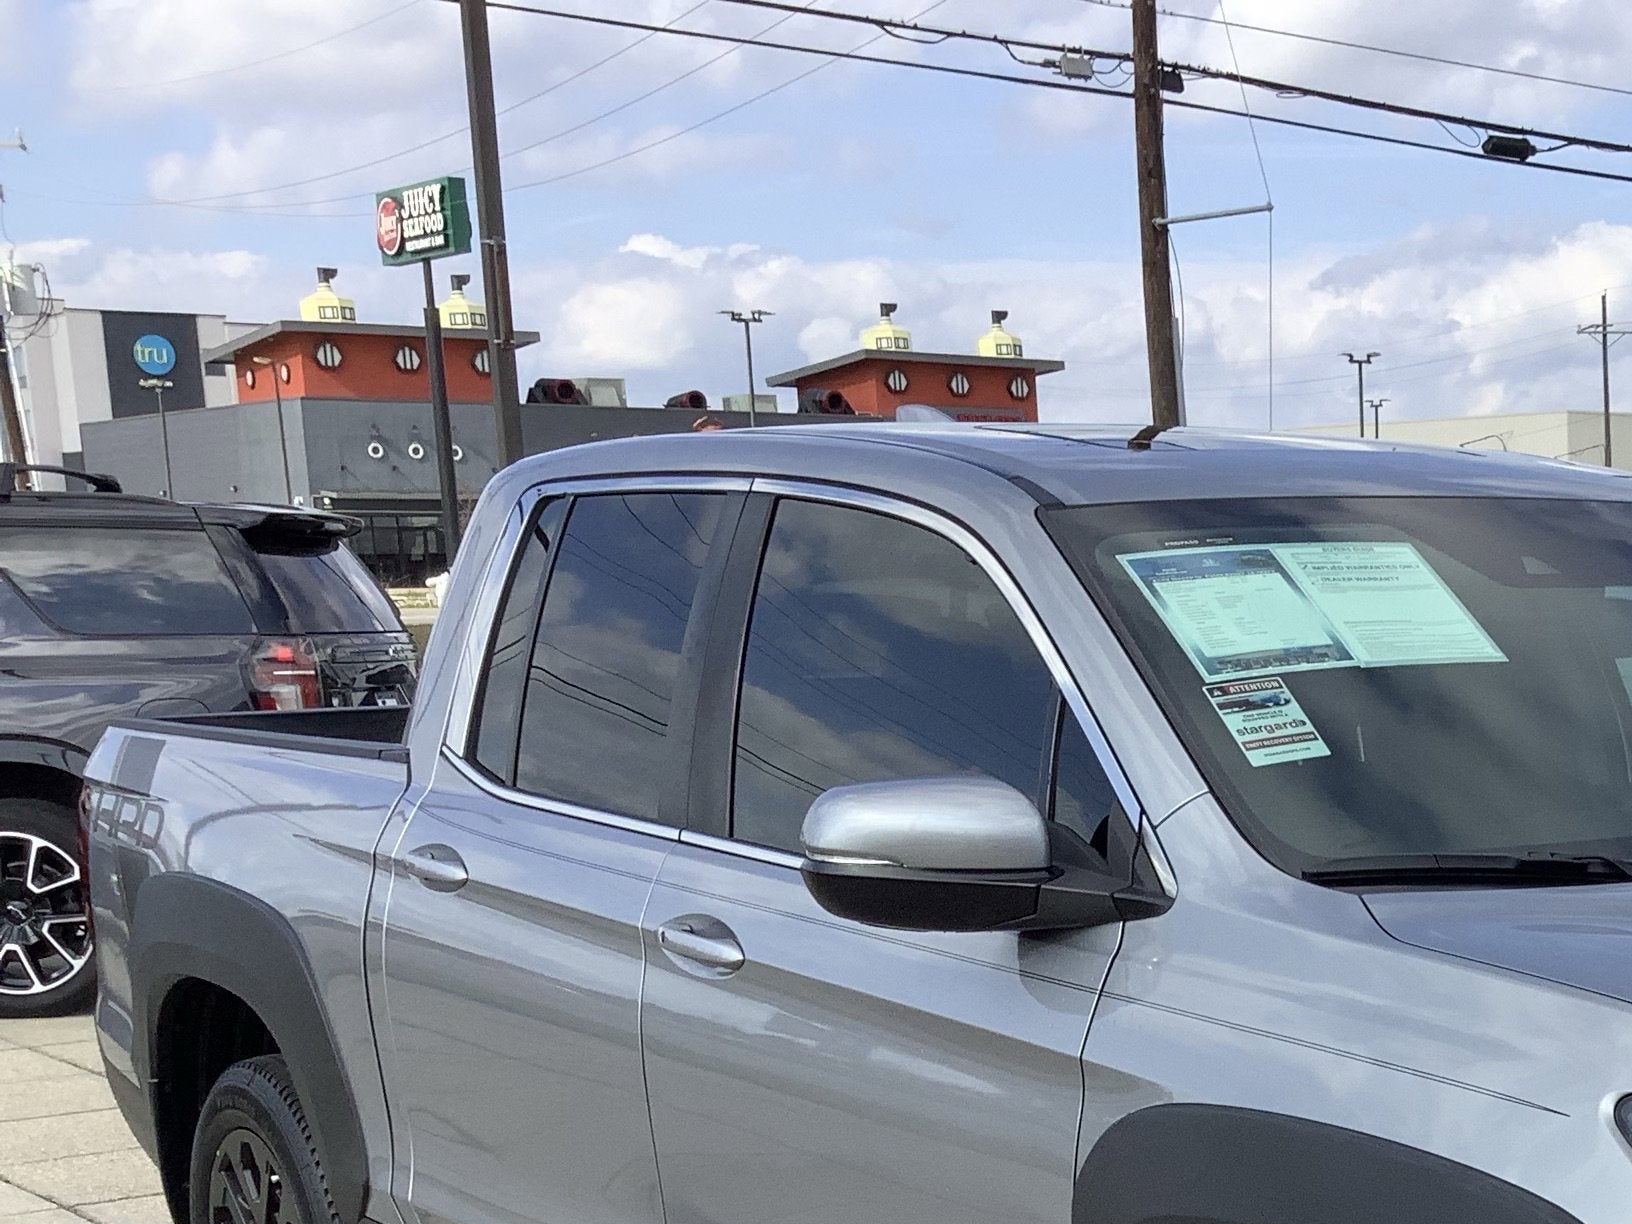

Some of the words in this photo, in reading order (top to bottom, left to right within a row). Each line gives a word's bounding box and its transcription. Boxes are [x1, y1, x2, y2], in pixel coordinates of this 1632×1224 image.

[401, 183, 441, 219] JUICY
[403, 212, 444, 238] SEAFOOD
[136, 343, 167, 364] tru
[1229, 680, 1280, 694] ATTENTION
[1236, 719, 1299, 736] stargard
